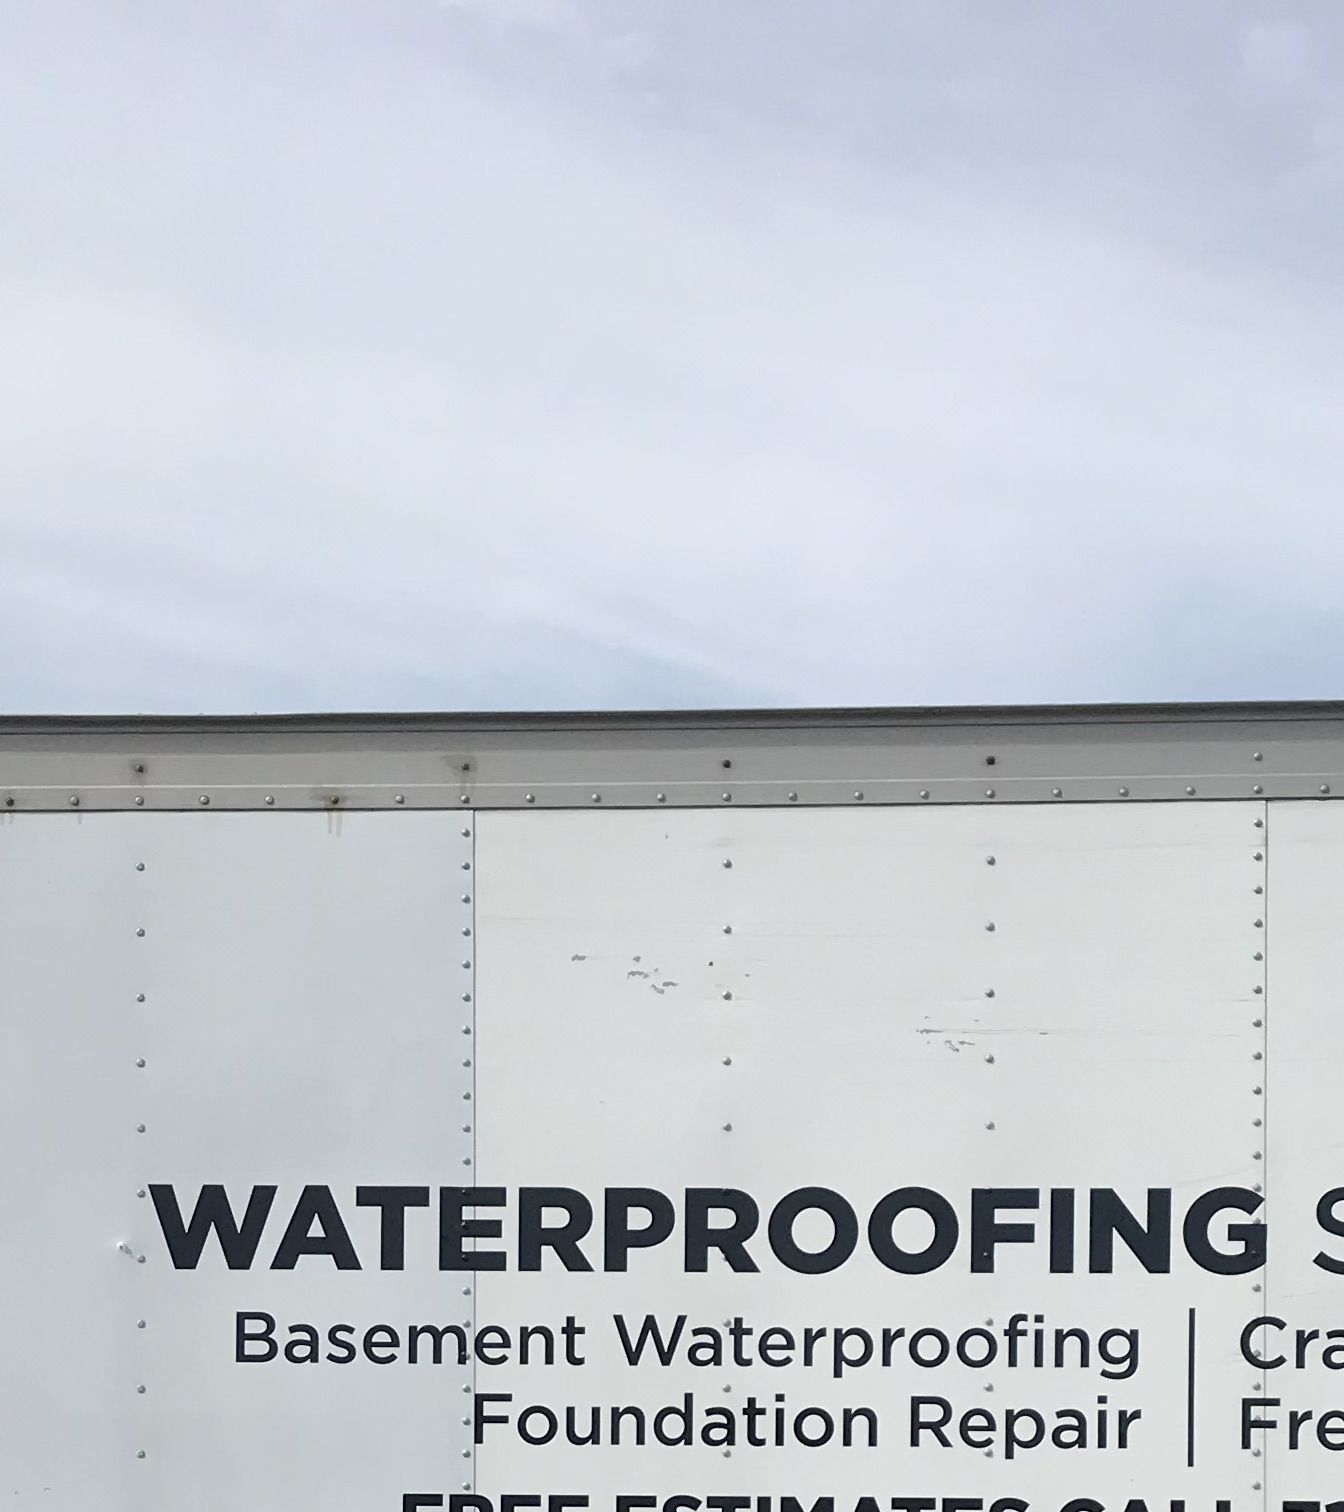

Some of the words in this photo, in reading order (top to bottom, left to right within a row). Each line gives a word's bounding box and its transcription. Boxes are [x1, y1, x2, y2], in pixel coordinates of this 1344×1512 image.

[148, 1183, 1268, 1276] WATERPROOFING
[235, 1311, 586, 1366] Basement
[613, 1313, 1139, 1380] Waterproofing
[473, 1392, 878, 1448] Foundation
[910, 1395, 1142, 1460] Repair
